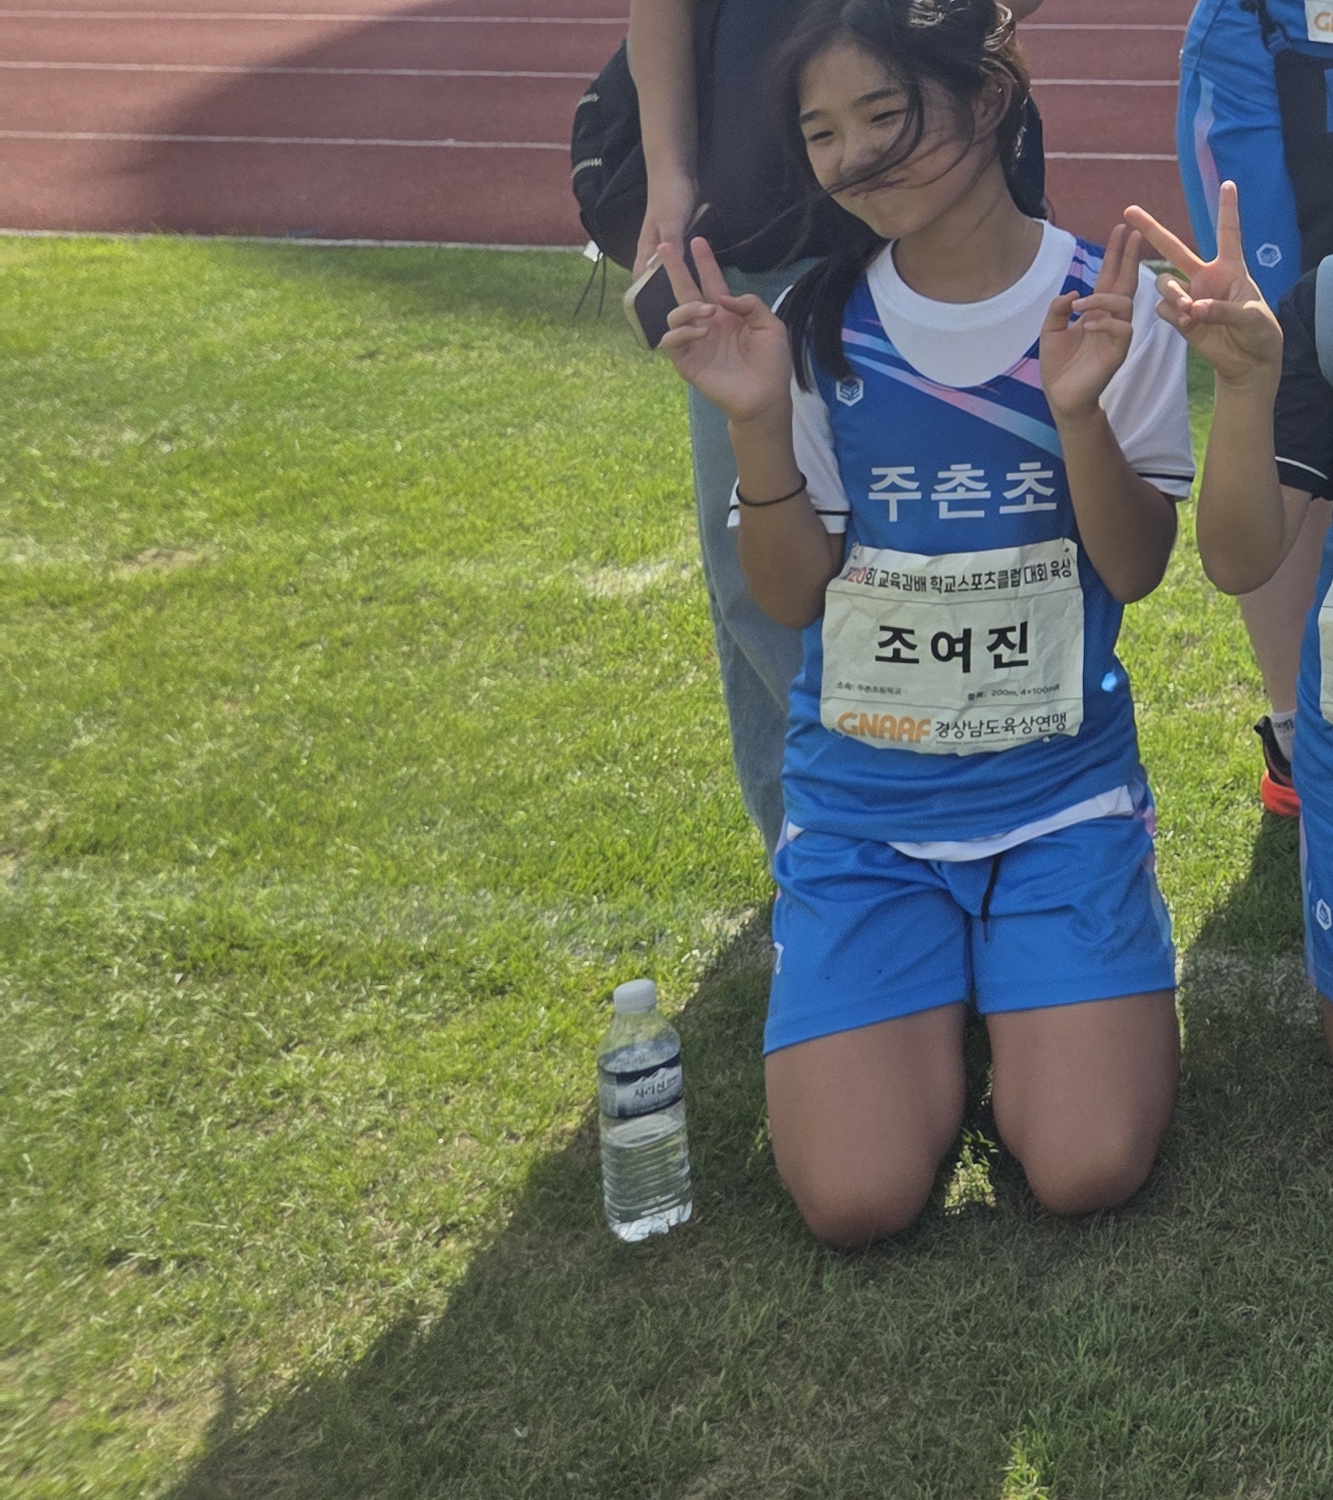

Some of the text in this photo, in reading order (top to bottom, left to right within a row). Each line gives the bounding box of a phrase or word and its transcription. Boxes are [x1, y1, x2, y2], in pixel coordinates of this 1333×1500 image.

[868, 461, 1057, 522] 주촌초
[878, 570, 927, 592] 교육감배
[930, 568, 1021, 593] 학교스포츠클럽
[1023, 563, 1048, 584] 대회
[1050, 558, 1072, 578] 육상
[875, 621, 1029, 674] 조여진
[837, 711, 931, 743] GNAAF
[935, 712, 1067, 739] 경상남도육상연맹
